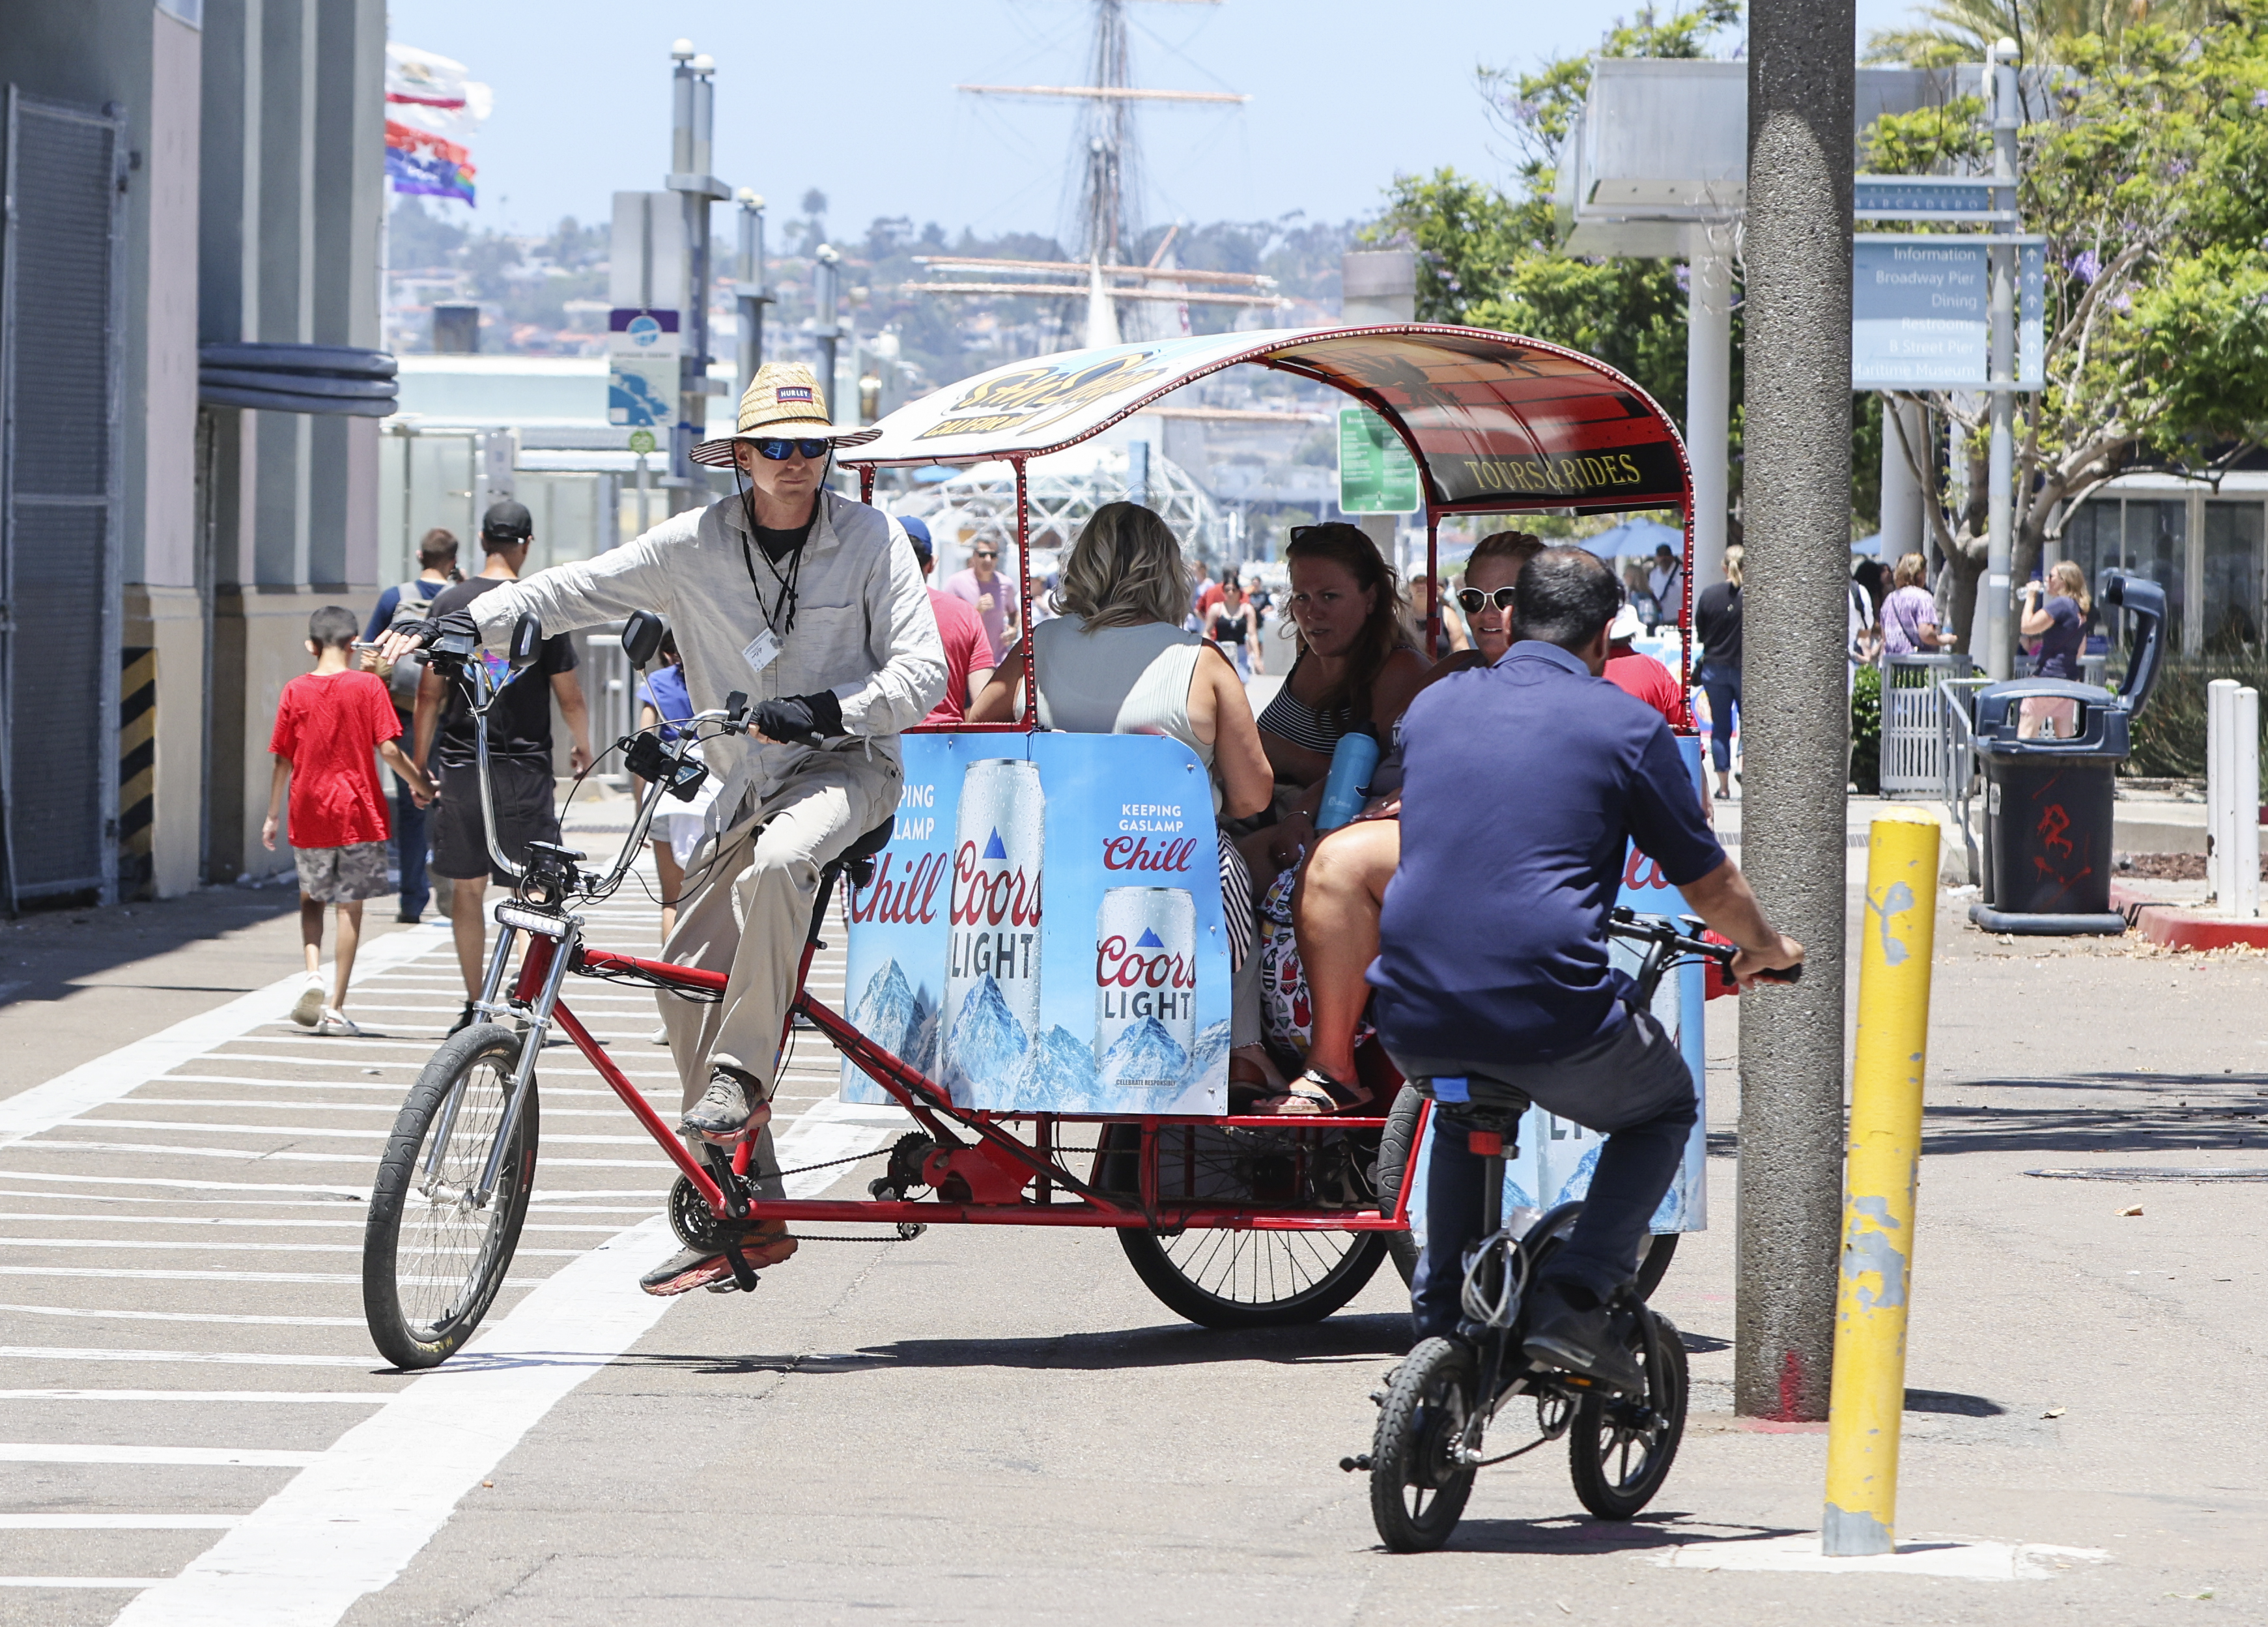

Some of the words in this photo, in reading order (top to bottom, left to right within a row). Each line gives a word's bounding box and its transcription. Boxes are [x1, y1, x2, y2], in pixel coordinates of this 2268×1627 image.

[1854, 197, 1978, 210] BARCADERO
[1893, 247, 1976, 261] Information
[1875, 270, 1944, 287] Broadway
[1949, 270, 1974, 285] Pier
[1932, 293, 1977, 311] Dining
[1901, 317, 1976, 331] Restrooms
[1890, 339, 1898, 353] B
[1903, 339, 1943, 354] Street
[1948, 339, 1974, 354] Pier
[1852, 362, 1911, 376] Maritime
[1916, 363, 1976, 376] Museum
[898, 784, 935, 808] PING
[1122, 804, 1182, 817] KEEPING
[893, 817, 935, 841] LAMP
[1118, 819, 1184, 832] GASLAMP
[1102, 836, 1197, 872] Chill
[950, 840, 1042, 927] Coors
[951, 932, 1034, 979] LIGHT
[1097, 935, 1197, 989] Coors
[1104, 991, 1191, 1020] LIGHT
